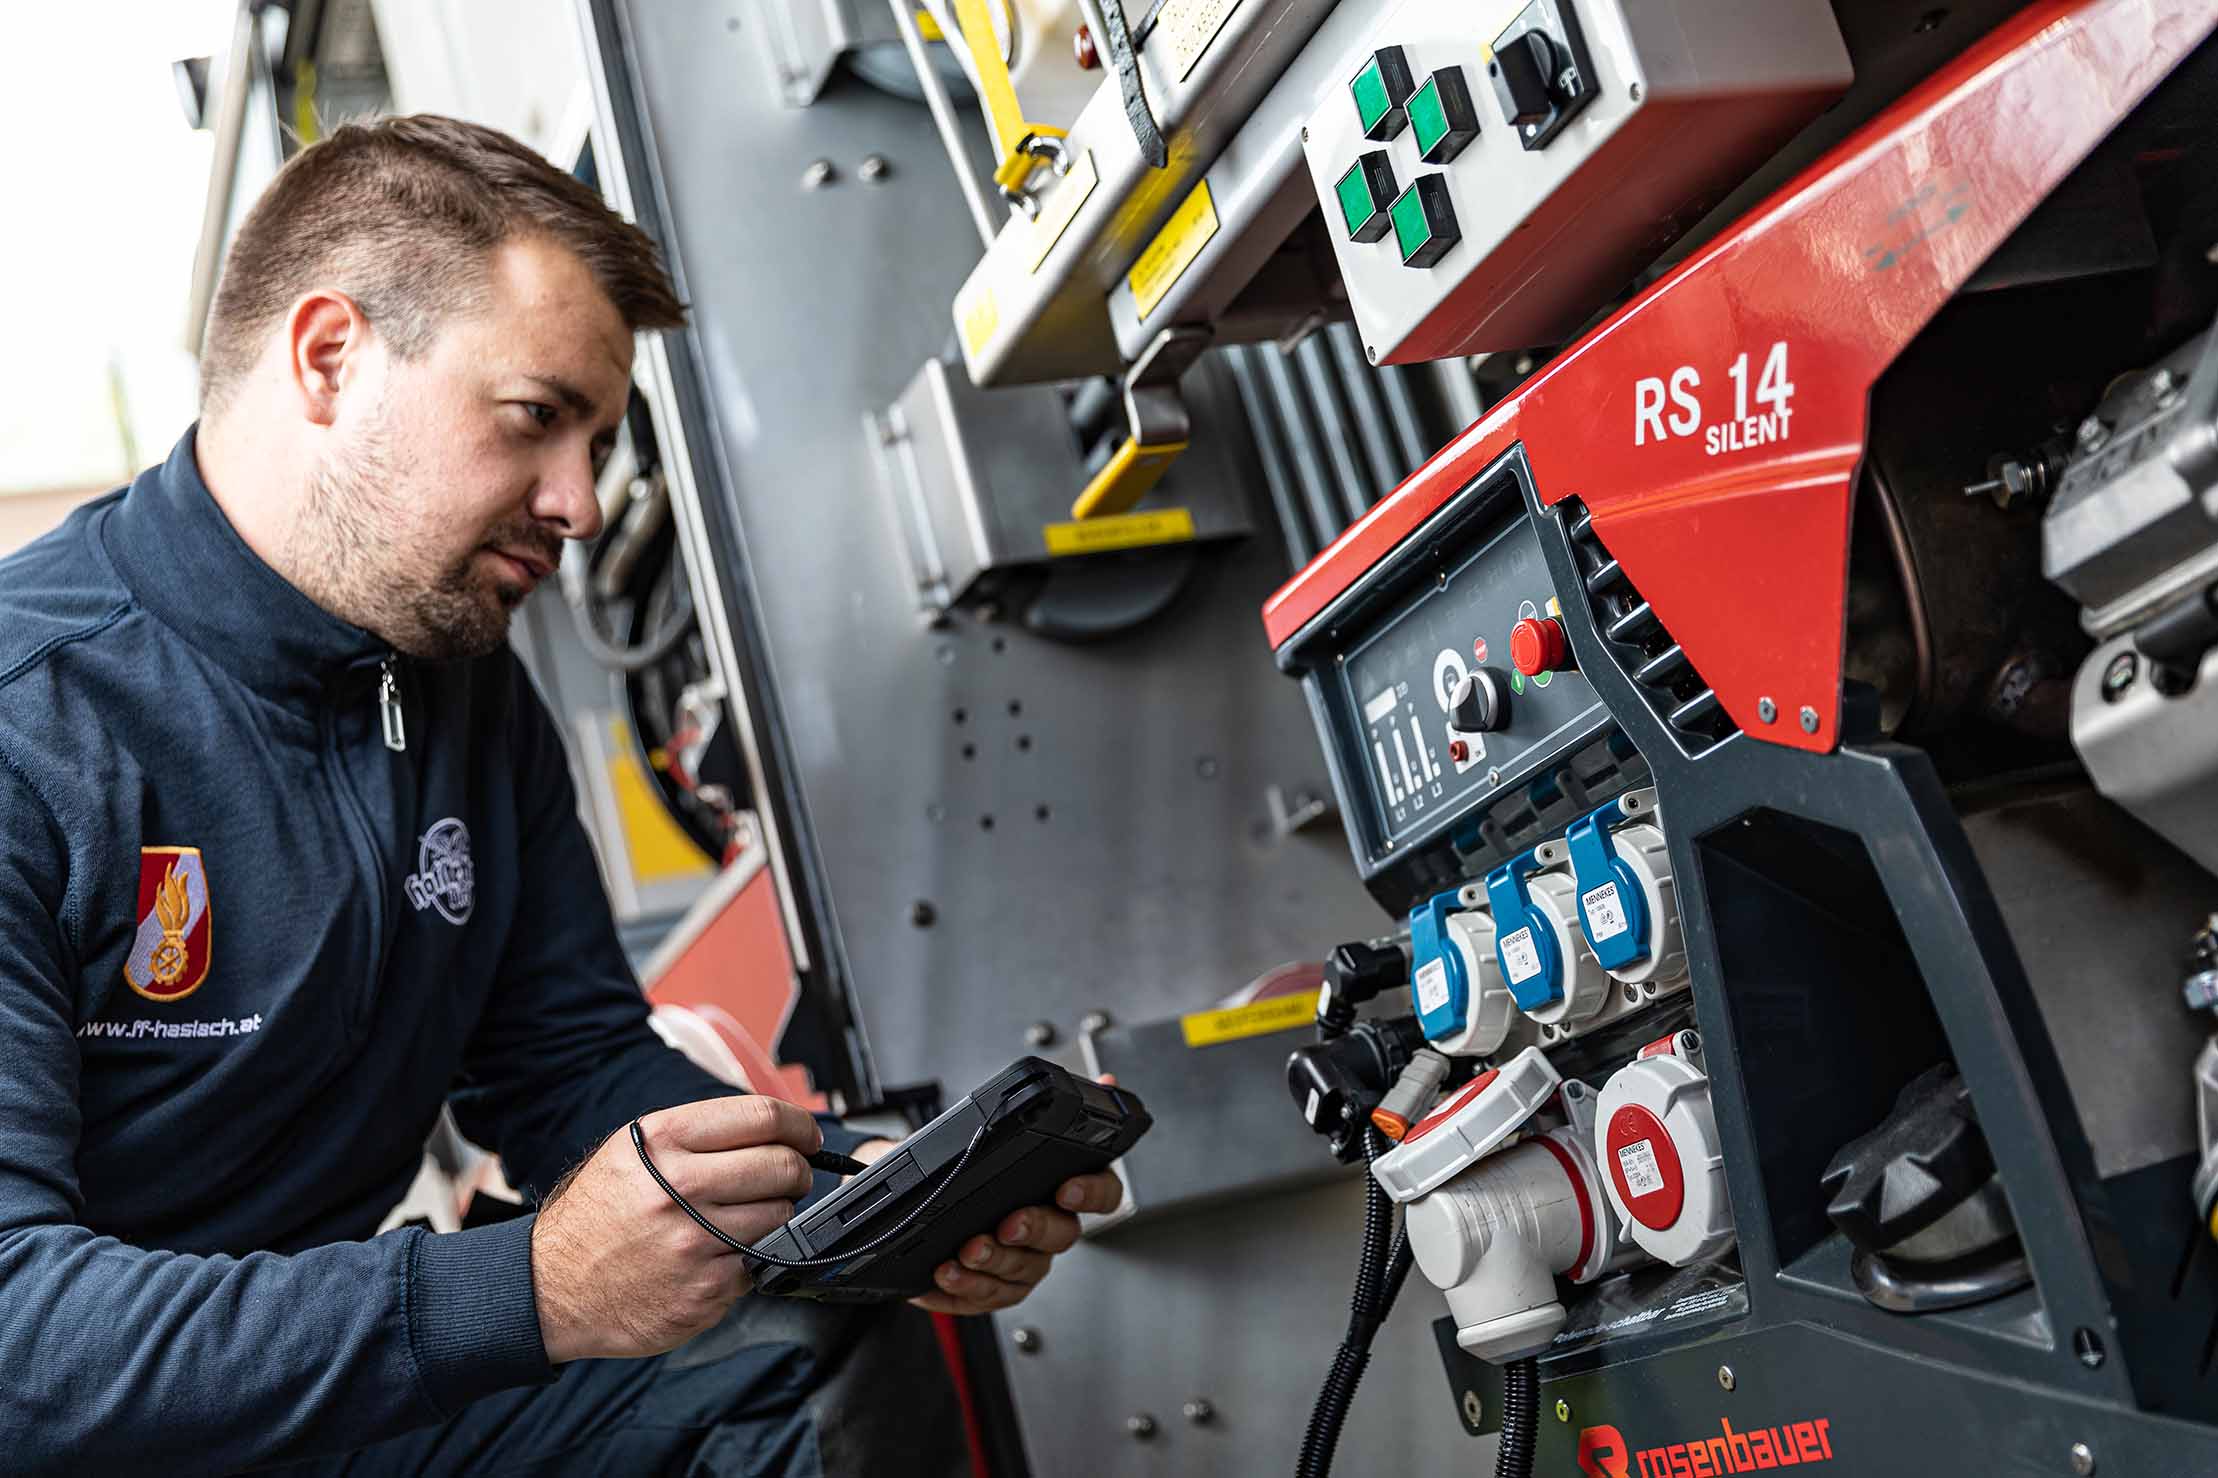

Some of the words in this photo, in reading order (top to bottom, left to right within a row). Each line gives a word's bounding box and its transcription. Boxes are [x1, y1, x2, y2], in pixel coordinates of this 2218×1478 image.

[1635, 366, 1702, 446] RS
[1728, 341, 1795, 421] 14
[1705, 408, 1793, 456] SILENT
[1585, 886, 1615, 905] MENNEKES
[1634, 1417, 1834, 1478] rosenbauer
